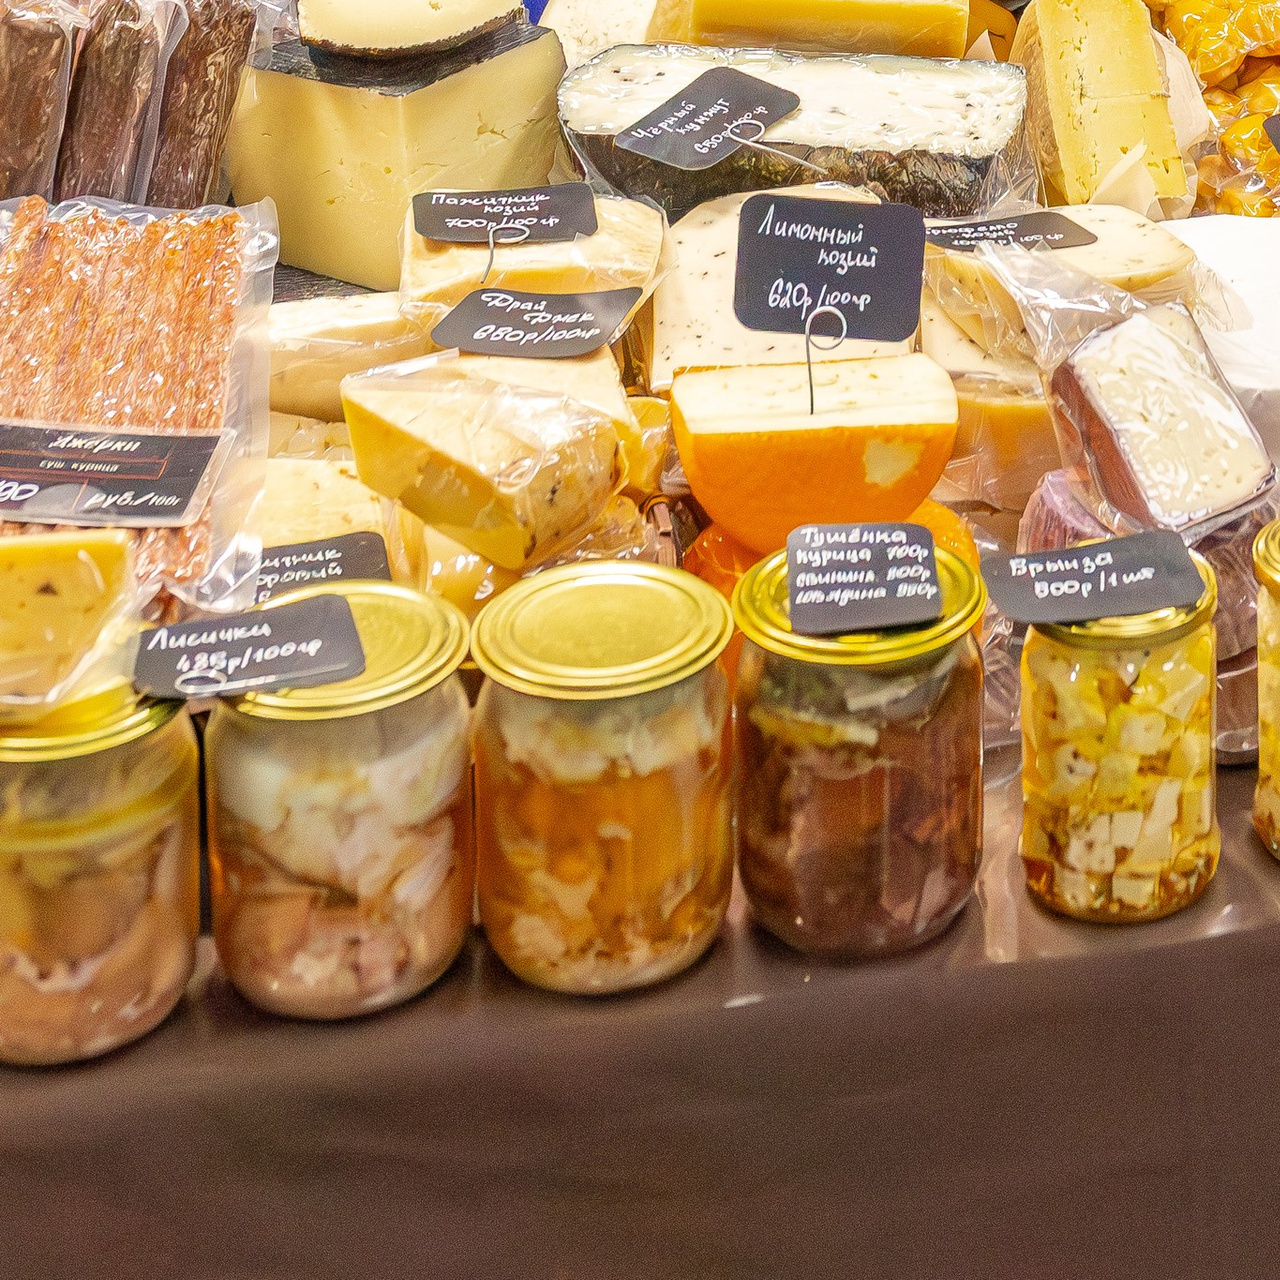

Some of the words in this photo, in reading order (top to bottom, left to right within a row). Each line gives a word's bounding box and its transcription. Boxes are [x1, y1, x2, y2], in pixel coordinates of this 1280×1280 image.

[631, 100, 696, 139] Чёрный
[484, 203, 540, 215] козий
[758, 203, 864, 245] Лимонный
[818, 246, 878, 275] козий
